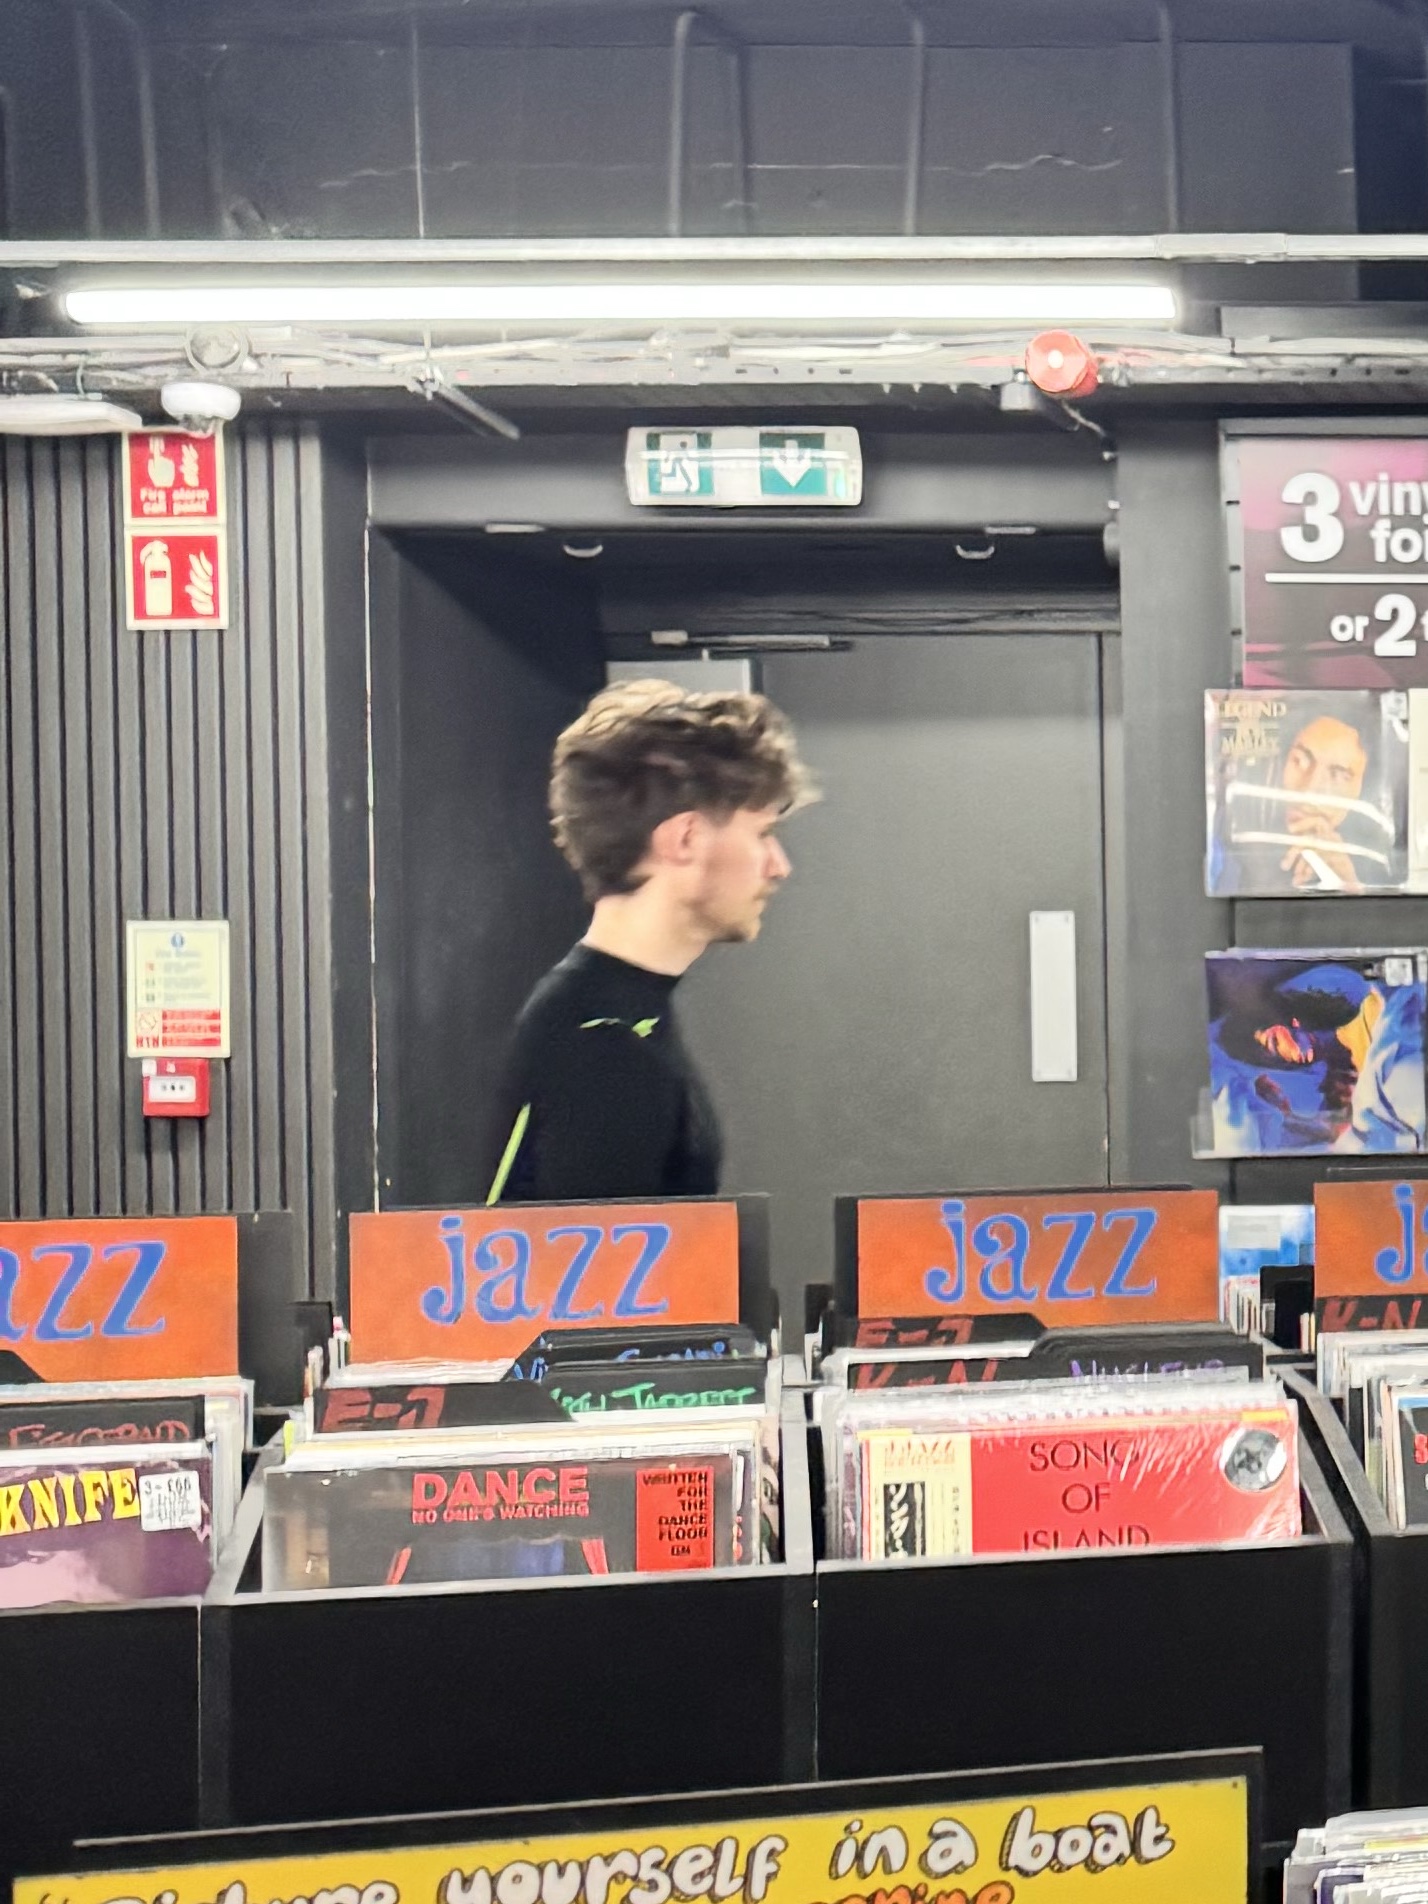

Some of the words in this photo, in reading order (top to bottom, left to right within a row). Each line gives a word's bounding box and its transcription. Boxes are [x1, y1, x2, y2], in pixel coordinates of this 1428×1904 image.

[1280, 471, 1344, 562] 3
[1331, 612, 1368, 642] or
[1374, 593, 1417, 657] 2
[422, 1217, 671, 1325] jazz
[926, 1201, 1158, 1303] jazz
[412, 1467, 589, 1510] DANCE
[643, 1472, 708, 1485] WRITTEN
[677, 1487, 708, 1498] FOR
[1062, 1484, 1111, 1513] OF
[0, 1468, 140, 1536] KNIFE
[413, 1510, 436, 1524] NO
[501, 1501, 589, 1520] WATCHING
[658, 1515, 708, 1527] DANCE
[679, 1500, 708, 1511] THE
[830, 1820, 907, 1878] in
[919, 1818, 977, 1878] a
[999, 1806, 1175, 1877] boat
